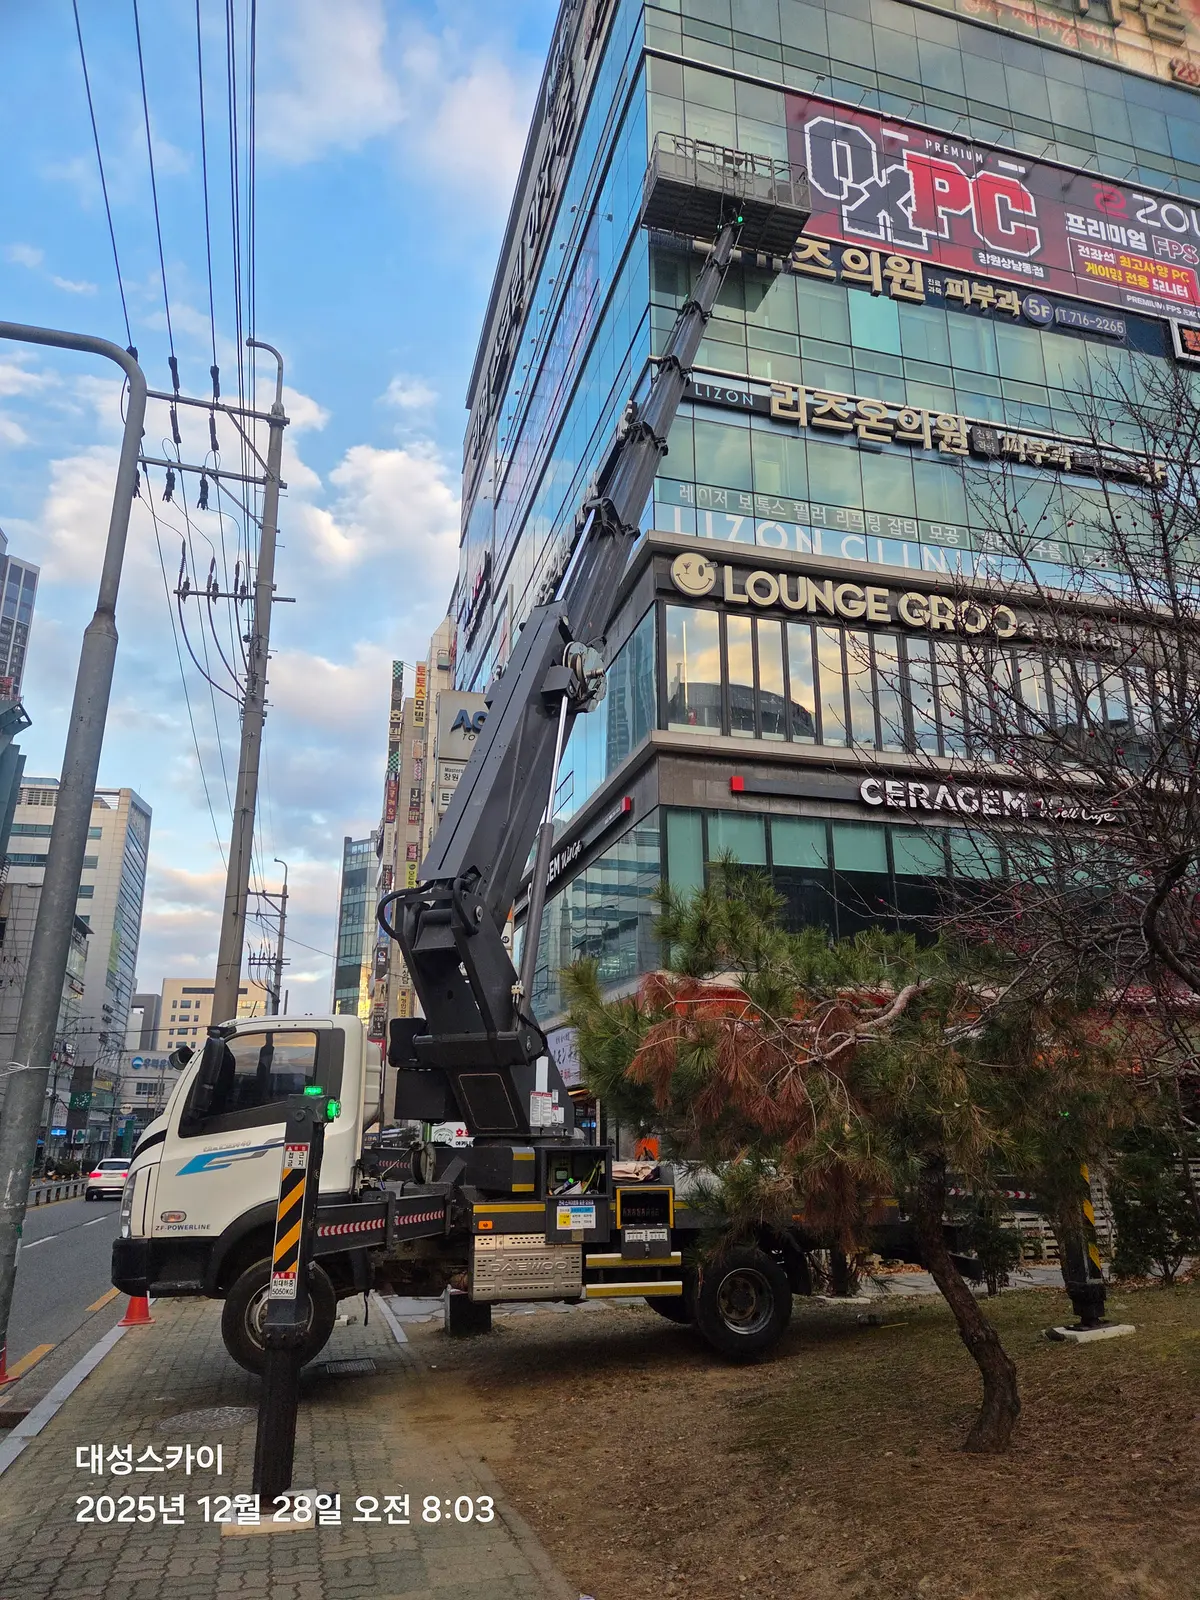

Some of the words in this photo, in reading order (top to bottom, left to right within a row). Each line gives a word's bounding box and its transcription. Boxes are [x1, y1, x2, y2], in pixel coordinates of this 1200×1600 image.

[1175, 58, 1200, 83] 28
[925, 139, 983, 164] PREMIUM
[1065, 212, 1148, 251] 프리미엄
[1151, 234, 1200, 265] FPS
[978, 252, 1044, 278] 창원상남동점
[1077, 244, 1116, 264] 전좌석
[1119, 255, 1169, 279] 최고사양
[1171, 269, 1190, 283] PC
[1084, 261, 1123, 282] 게이밍
[1125, 271, 1149, 288] 전용
[944, 278, 1022, 318] 피부과
[1029, 299, 1050, 318] 5F
[1166, 302, 1182, 314] FPS
[1060, 309, 1124, 334] T.716-2265
[694, 382, 754, 407] LIZON
[768, 382, 971, 456] 리즈온의원
[674, 506, 823, 556] LIZON
[679, 484, 728, 509] 레이저
[739, 494, 786, 516] 보톡스
[793, 500, 828, 525] 필러
[836, 509, 881, 532] 리프팅
[887, 517, 919, 540] 잡티
[928, 524, 960, 545] 모공
[724, 564, 892, 623] LOUNGE
[898, 591, 1018, 639] GROO
[860, 778, 1028, 817] CERAGEM
